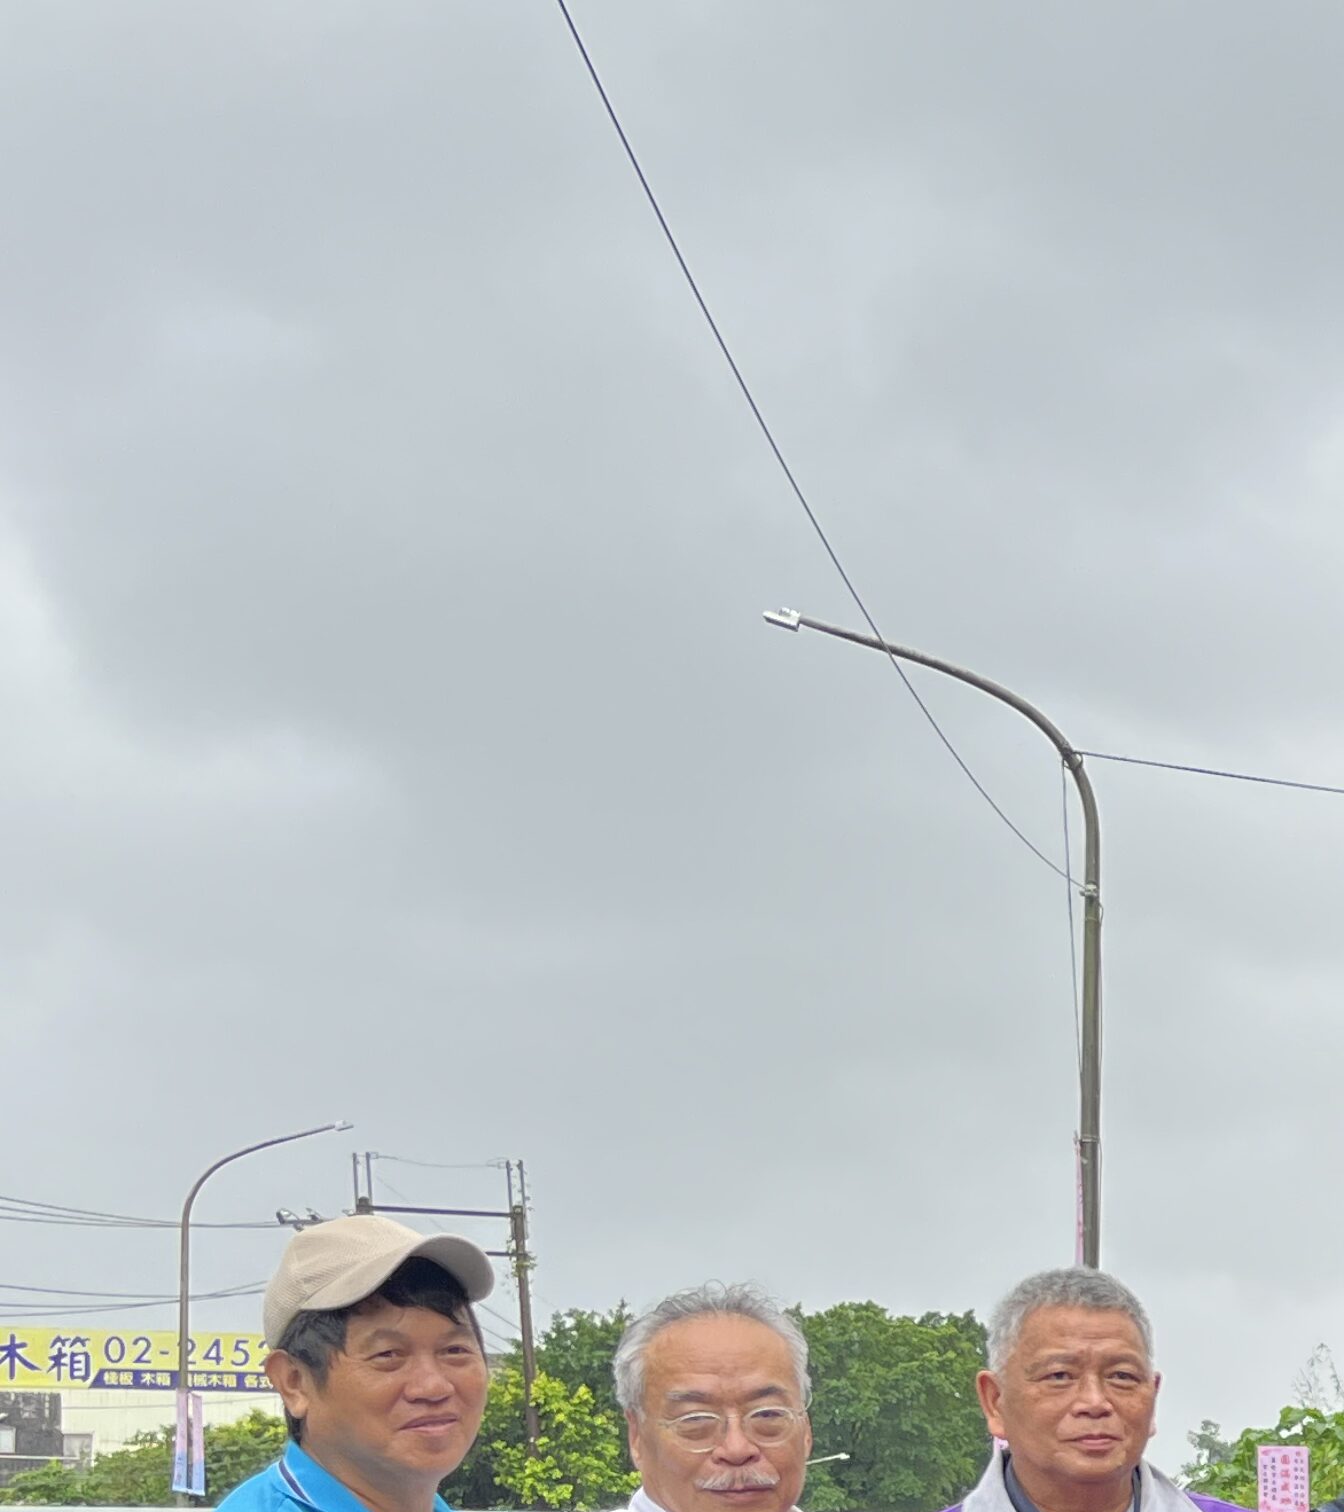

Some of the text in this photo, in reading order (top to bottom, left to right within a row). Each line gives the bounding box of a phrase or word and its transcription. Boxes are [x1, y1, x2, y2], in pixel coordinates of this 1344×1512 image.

[0, 1333, 90, 1382] 木箱
[188, 1373, 238, 1388] 械木箱
